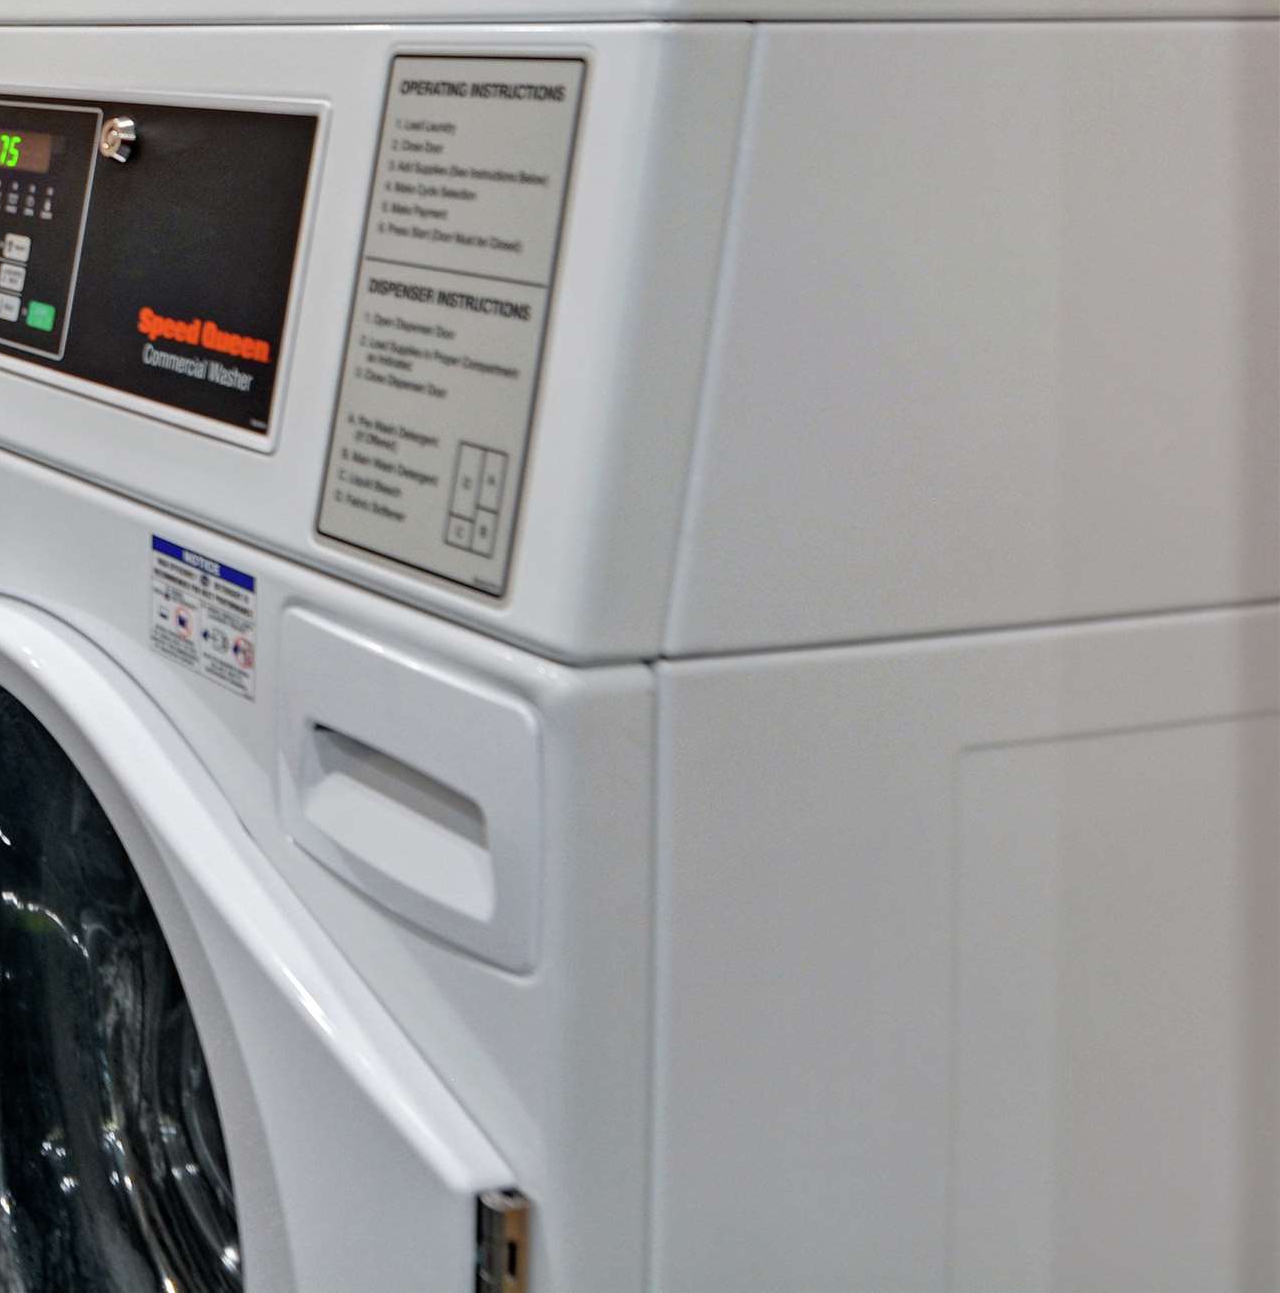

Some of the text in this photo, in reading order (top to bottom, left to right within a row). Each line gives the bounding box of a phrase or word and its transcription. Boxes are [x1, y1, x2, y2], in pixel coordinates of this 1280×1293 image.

[400, 78, 567, 102] OPERATING INSTRUCTIONS
[368, 277, 532, 322] DISPENSER INSTRUCTIONS
[137, 306, 270, 363] Speed Queen
[142, 342, 254, 392] Commercial Washer
